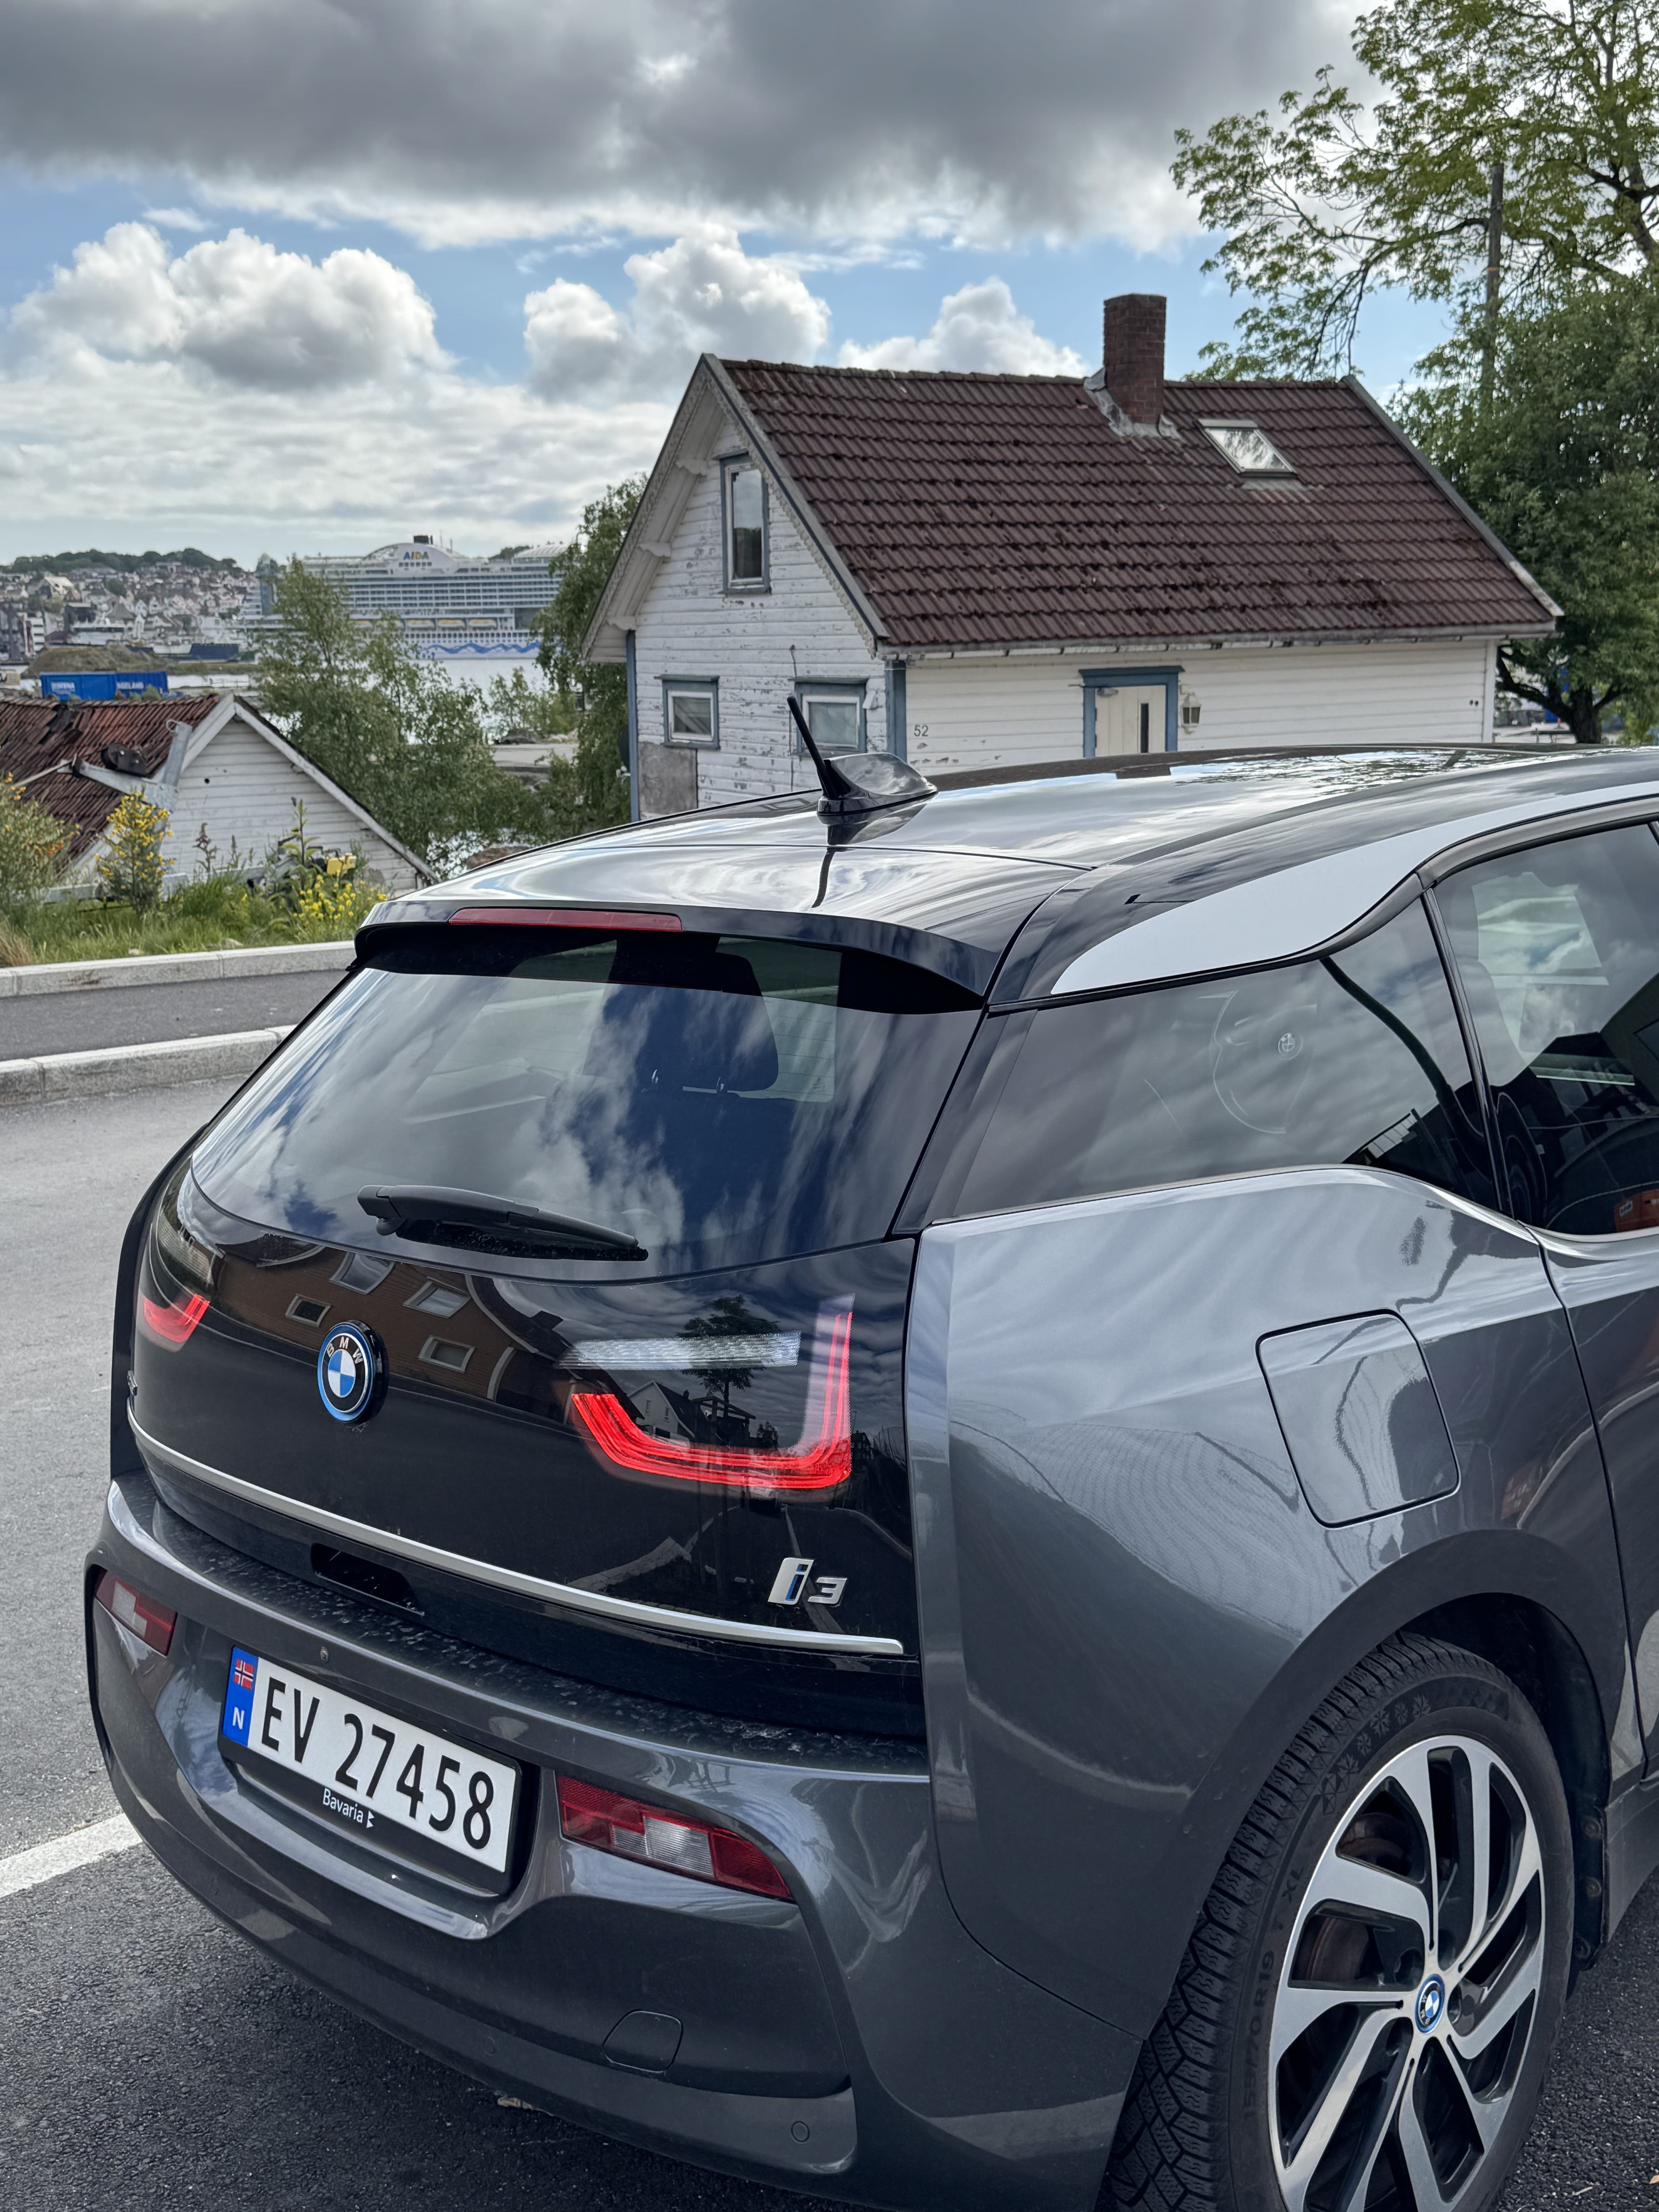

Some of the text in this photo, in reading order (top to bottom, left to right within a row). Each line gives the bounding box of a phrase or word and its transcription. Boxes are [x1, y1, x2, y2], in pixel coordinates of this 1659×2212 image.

[403, 551, 429, 560] AIDA
[914, 725, 928, 737] 52
[327, 1336, 363, 1364] BMW
[768, 1557, 847, 1604] i3
[232, 1707, 245, 1729] N
[261, 1677, 494, 1850] EV 27458
[323, 1788, 363, 1823] Bavaria
[1255, 1950, 1274, 2007] R19
[1281, 1865, 1304, 1903] XL
